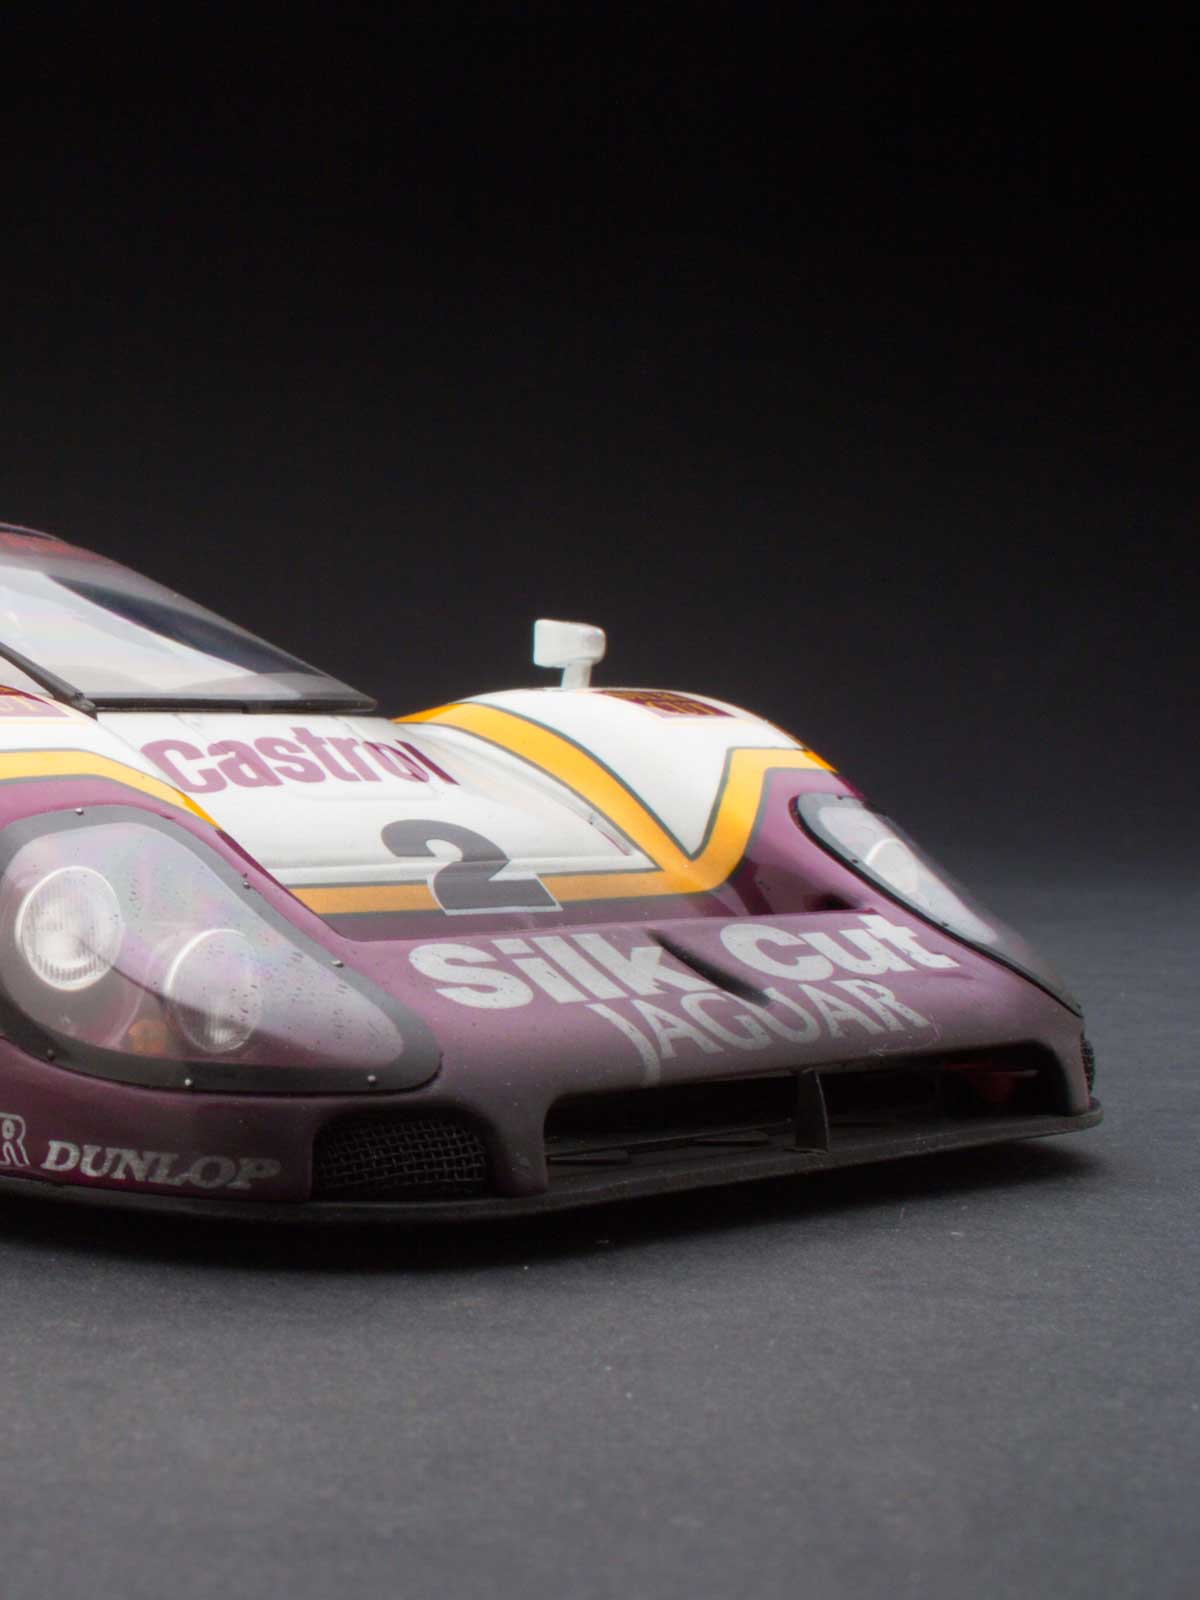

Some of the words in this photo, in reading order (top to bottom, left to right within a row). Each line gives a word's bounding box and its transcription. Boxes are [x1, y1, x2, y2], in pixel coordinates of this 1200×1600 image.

[140, 727, 460, 794] Castrol
[380, 819, 560, 915] 2
[408, 933, 715, 1010] Silk
[720, 915, 960, 981] Cut
[586, 979, 930, 1087] JAGUAR
[41, 1140, 281, 1190] DUNLOP
